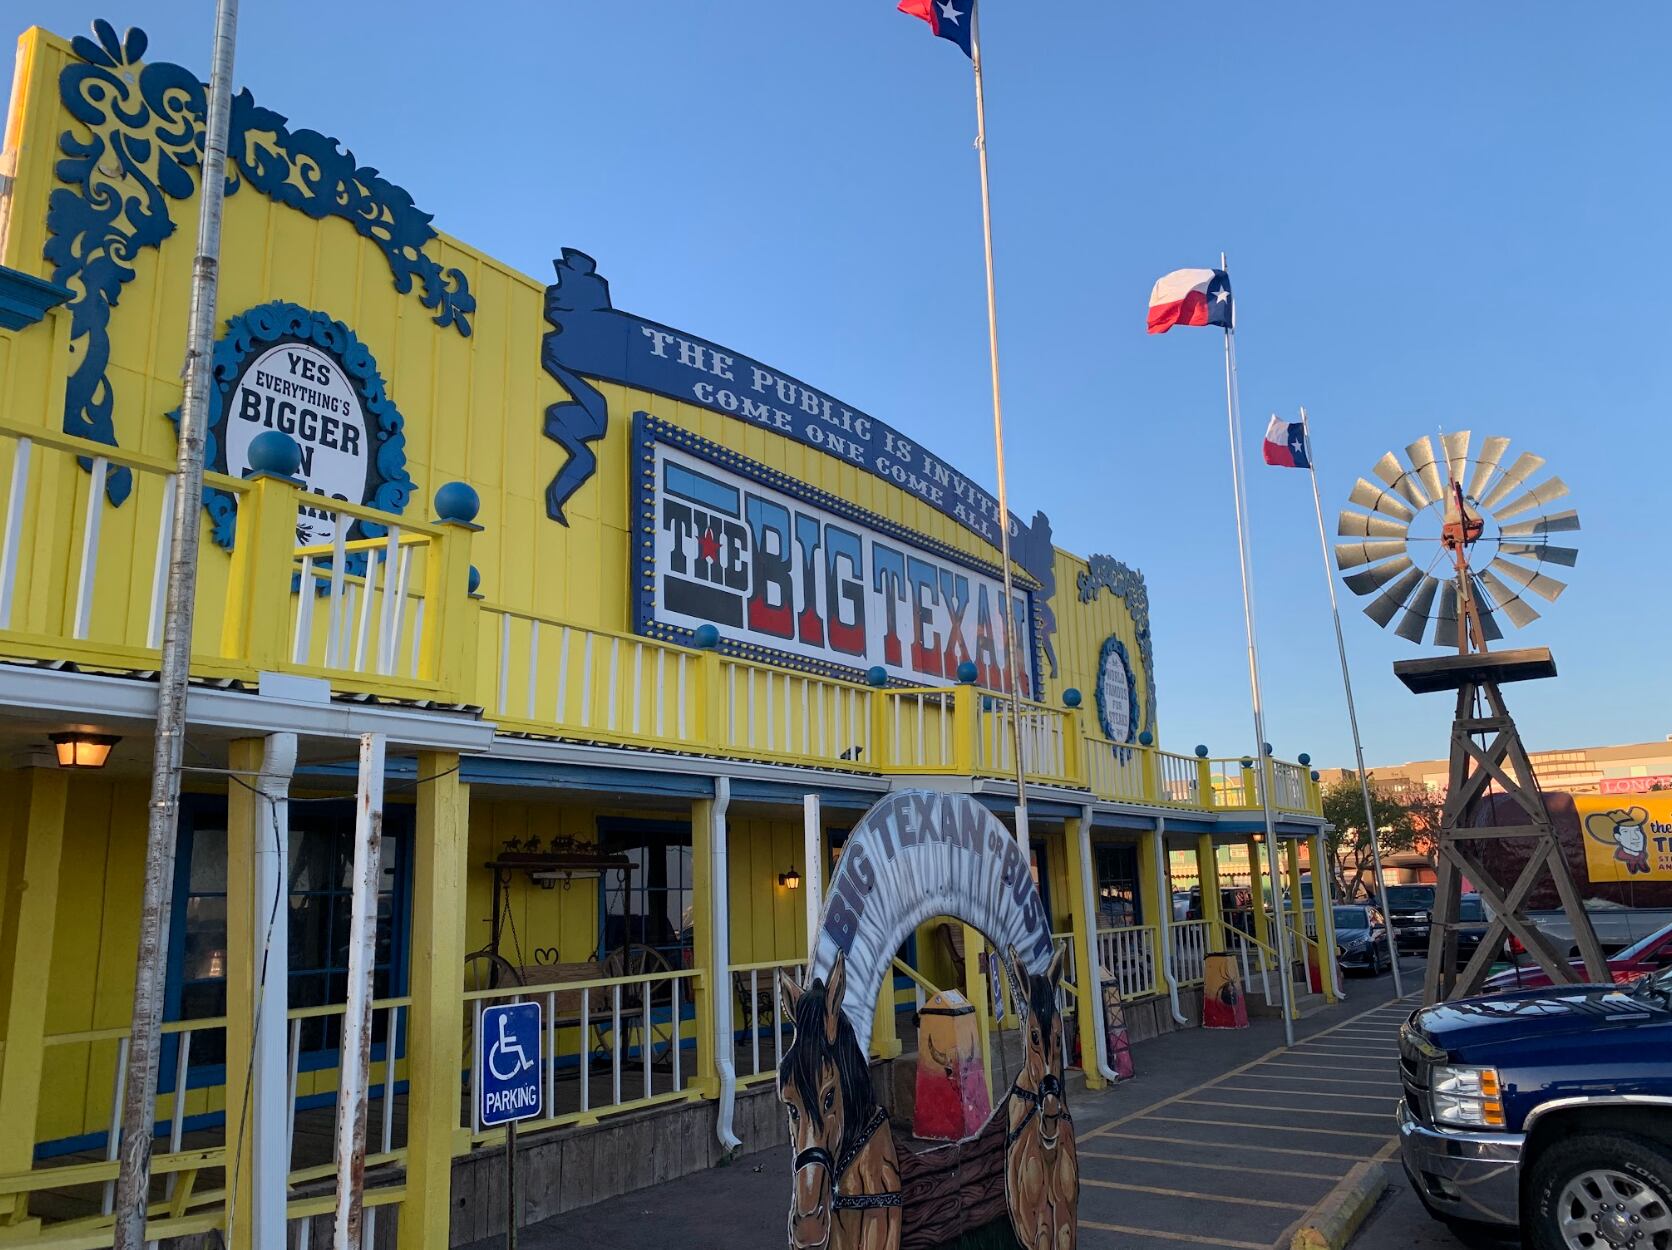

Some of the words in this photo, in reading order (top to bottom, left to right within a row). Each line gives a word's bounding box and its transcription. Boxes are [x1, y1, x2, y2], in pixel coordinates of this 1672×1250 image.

[255, 370, 351, 416] EVERYTHING'S
[287, 352, 330, 386] YES
[641, 326, 734, 381] THE
[751, 366, 871, 441] PUBLIC
[884, 430, 912, 462] IS
[239, 386, 360, 457] BIGGER
[693, 382, 792, 433] COME
[805, 424, 865, 464] ONE
[875, 456, 943, 505] COME
[953, 502, 992, 540] ALL
[663, 498, 748, 592] THE
[745, 490, 867, 661] BIG
[872, 540, 1030, 699] TEXAN
[824, 842, 875, 956] BIG
[867, 794, 986, 863] TEXAN
[988, 831, 1004, 860] OR
[1001, 838, 1054, 960] BUST
[486, 1085, 537, 1114] PARKING
[1625, 1161, 1672, 1203] COOP
